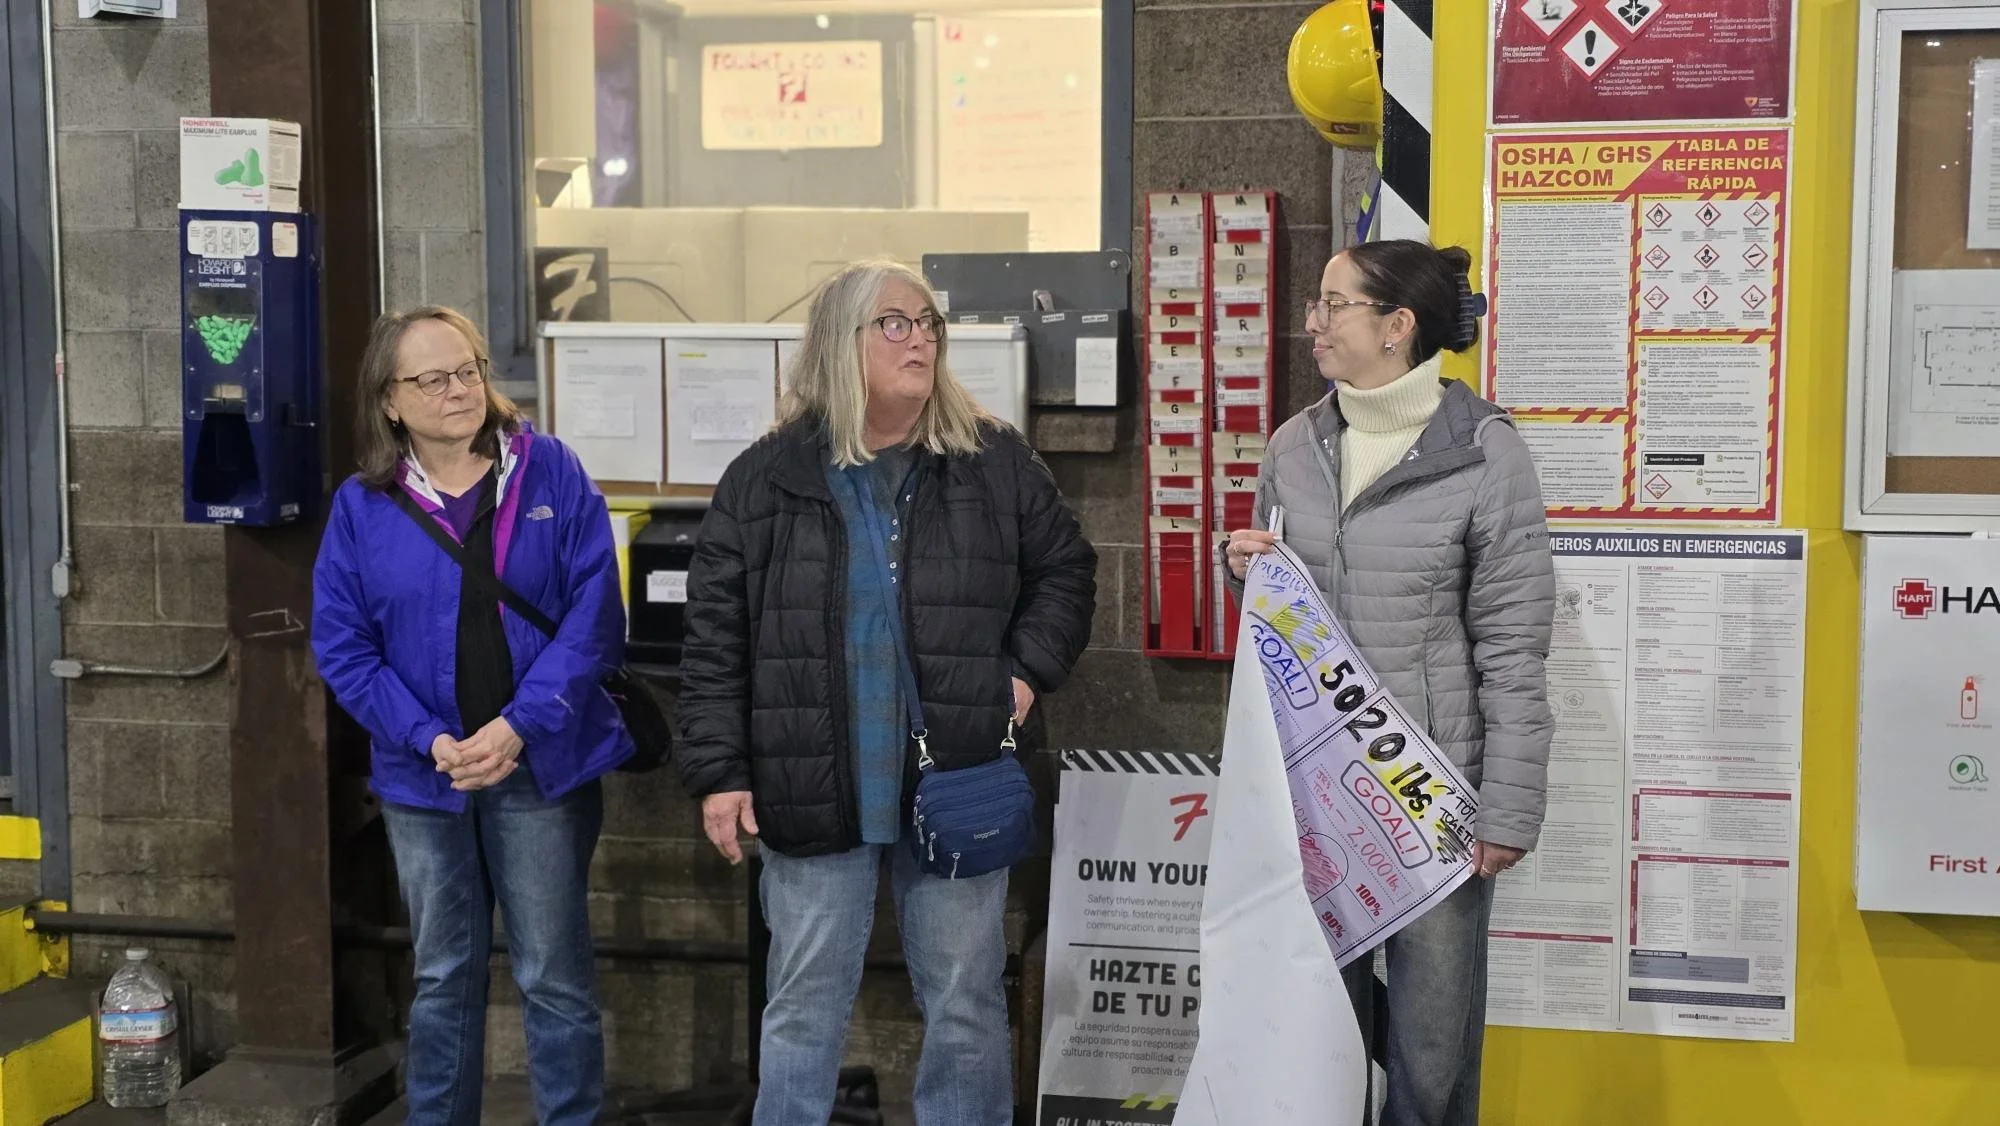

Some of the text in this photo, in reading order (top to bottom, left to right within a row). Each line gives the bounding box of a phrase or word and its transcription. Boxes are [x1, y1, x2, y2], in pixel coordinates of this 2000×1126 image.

[1676, 137, 1769, 153] TABLA DE
[1501, 144, 1653, 166] OSHA / GHS
[1662, 156, 1783, 172] REFERENCIA
[1501, 169, 1614, 188] HAZCOM
[1687, 174, 1757, 191] RÁPIDA
[1171, 195, 1179, 205] A
[1235, 195, 1246, 206] M
[1170, 246, 1179, 256] B
[1235, 244, 1244, 256] N
[198, 266, 232, 275] LEIGHT
[1236, 274, 1244, 284] P
[1169, 289, 1177, 299] C
[1170, 317, 1178, 328] D
[1240, 319, 1249, 331] R
[1171, 346, 1178, 356] E
[1235, 347, 1243, 357] S
[1172, 376, 1180, 387] F
[1171, 404, 1179, 414] G
[1234, 434, 1241, 445] T
[1169, 447, 1177, 458] H
[1235, 449, 1242, 459] V
[1171, 463, 1178, 473] J
[1230, 478, 1243, 488] W
[1171, 519, 1179, 529] L
[1595, 538, 1660, 553] AUXILIOS
[1663, 539, 1682, 553] EN
[1685, 539, 1787, 555] EMERGENCIAS
[1898, 594, 1932, 603] HART
[1250, 624, 1308, 697] GOAL!
[1353, 776, 1420, 856] GOAL!
[1456, 795, 1478, 825] TOT
[1929, 854, 1988, 874] First
[1078, 858, 1136, 883] OWN
[1087, 894, 1114, 906] Safety
[1116, 895, 1145, 906] thrives
[1147, 897, 1170, 907] when
[1171, 899, 1196, 910] every
[1355, 883, 1384, 918] 100%
[1132, 909, 1170, 921] fostering
[1172, 912, 1178, 920] a
[1086, 921, 1156, 934] communication,
[1157, 924, 1174, 933] and
[1321, 910, 1348, 939] 90%
[1089, 959, 1177, 986] HAZTE
[1093, 990, 1199, 1019] DE TU P
[1074, 1022, 1085, 1031] La
[1086, 1022, 1130, 1036] seguridad
[1131, 1025, 1171, 1039] prospera
[1069, 1035, 1100, 1046] equipo
[1100, 1037, 1130, 1046] asume
[1131, 1039, 1142, 1047] su
[1061, 1048, 1092, 1058] cultura
[1092, 1049, 1104, 1058] de
[1131, 1066, 1185, 1078] proactiva de
